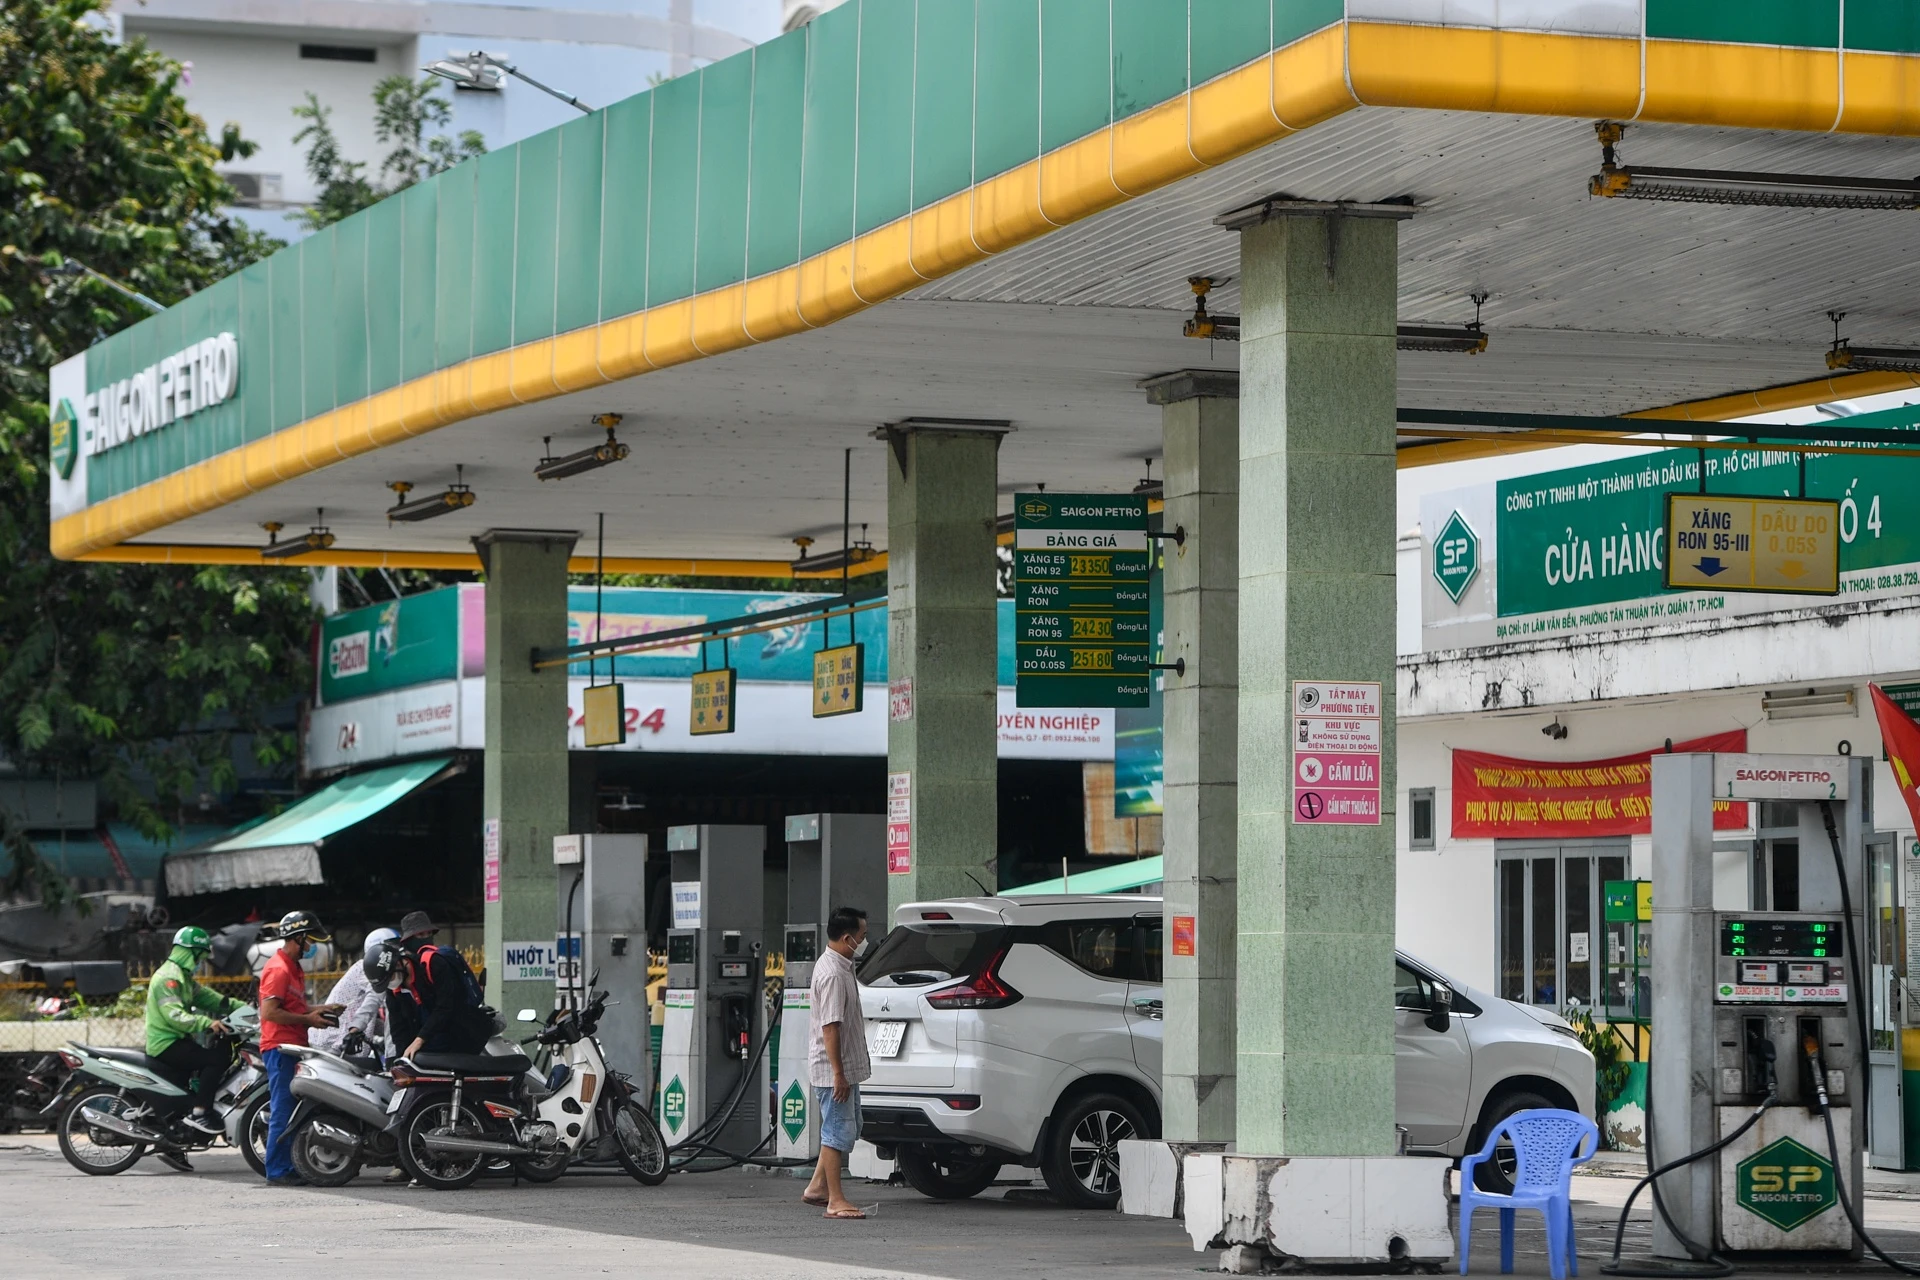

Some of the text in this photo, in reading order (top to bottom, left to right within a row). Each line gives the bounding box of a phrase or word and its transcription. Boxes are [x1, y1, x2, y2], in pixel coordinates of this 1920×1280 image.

[85, 332, 238, 457] SAIGON PETRO
[1506, 491, 1533, 512] CÔNG
[1535, 489, 1547, 507] TY
[1549, 485, 1576, 504] TNHH
[1578, 477, 1599, 501] MỘT
[1601, 472, 1634, 494] THÀNH
[1637, 466, 1659, 489] VIÊN
[1662, 459, 1683, 484] DẦU
[1686, 462, 1699, 479] KH
[1704, 458, 1721, 477] TP.
[1723, 449, 1738, 474] HỒ
[1024, 504, 1047, 513] SP
[1060, 507, 1142, 517] SAIGON PETRO
[1691, 508, 1731, 530] XĂNG
[1761, 507, 1828, 534] DẦU DO
[1046, 532, 1117, 547] BẢNG GIÁ
[1545, 526, 1594, 586] CỬA
[1601, 522, 1663, 577] HÀNG
[1867, 494, 1882, 539] 4
[1677, 531, 1749, 552] RON 95-III
[1769, 535, 1817, 555] 0.05S
[1023, 554, 1065, 564] XĂNG E5
[1443, 538, 1468, 566] SP
[1026, 566, 1061, 575] RON 92
[1072, 557, 1109, 573] 23350
[1031, 585, 1059, 595] XĂNG
[1849, 577, 1875, 593] THOẠI:
[1028, 597, 1049, 606] RON
[1031, 615, 1059, 626] XĂNG
[1496, 624, 1507, 639] ĐỊA
[1522, 622, 1530, 634] 01
[1531, 618, 1545, 633] LÂM
[1547, 616, 1560, 630] VĂN
[1610, 608, 1624, 622] TÂN
[1625, 604, 1649, 621] THUẬN
[1650, 602, 1666, 617] TÂY,
[1667, 599, 1688, 617] QUẬN
[1689, 601, 1696, 614] 7,
[1697, 596, 1725, 612] TP.HCM
[1028, 629, 1062, 638] RON 95
[1074, 620, 1111, 636] 24230
[1023, 660, 1066, 669] DO 0.05S
[1074, 652, 1111, 667] 25180
[1347, 688, 1367, 700] MÁY
[1320, 703, 1375, 715] PHƯƠNG TIỆN
[1040, 713, 1101, 734] NGHIỆP
[1325, 721, 1360, 731] KHU VỰC
[1312, 732, 1338, 740] KHÔNG
[1307, 742, 1325, 750] ĐIỆN
[1327, 743, 1348, 751] THOẠI
[1328, 760, 1374, 781] CẤM LỬA
[1736, 769, 1831, 783] SAIGON PETRO
[1727, 780, 1734, 798] 1
[1829, 782, 1836, 799] 2
[1466, 801, 1487, 826] PHỤC
[1488, 801, 1500, 826] VỤ
[1562, 796, 1594, 825] NGHIỆP
[1595, 795, 1616, 820] HÓA
[506, 945, 544, 965] NHỚT
[520, 967, 528, 977] 73
[529, 967, 543, 977] 000
[882, 1022, 899, 1038] 51G
[666, 1092, 684, 1111] SP
[785, 1098, 804, 1117] SP
[1751, 1165, 1823, 1192] SP
[1751, 1193, 1823, 1203] SAIGON PETRO
